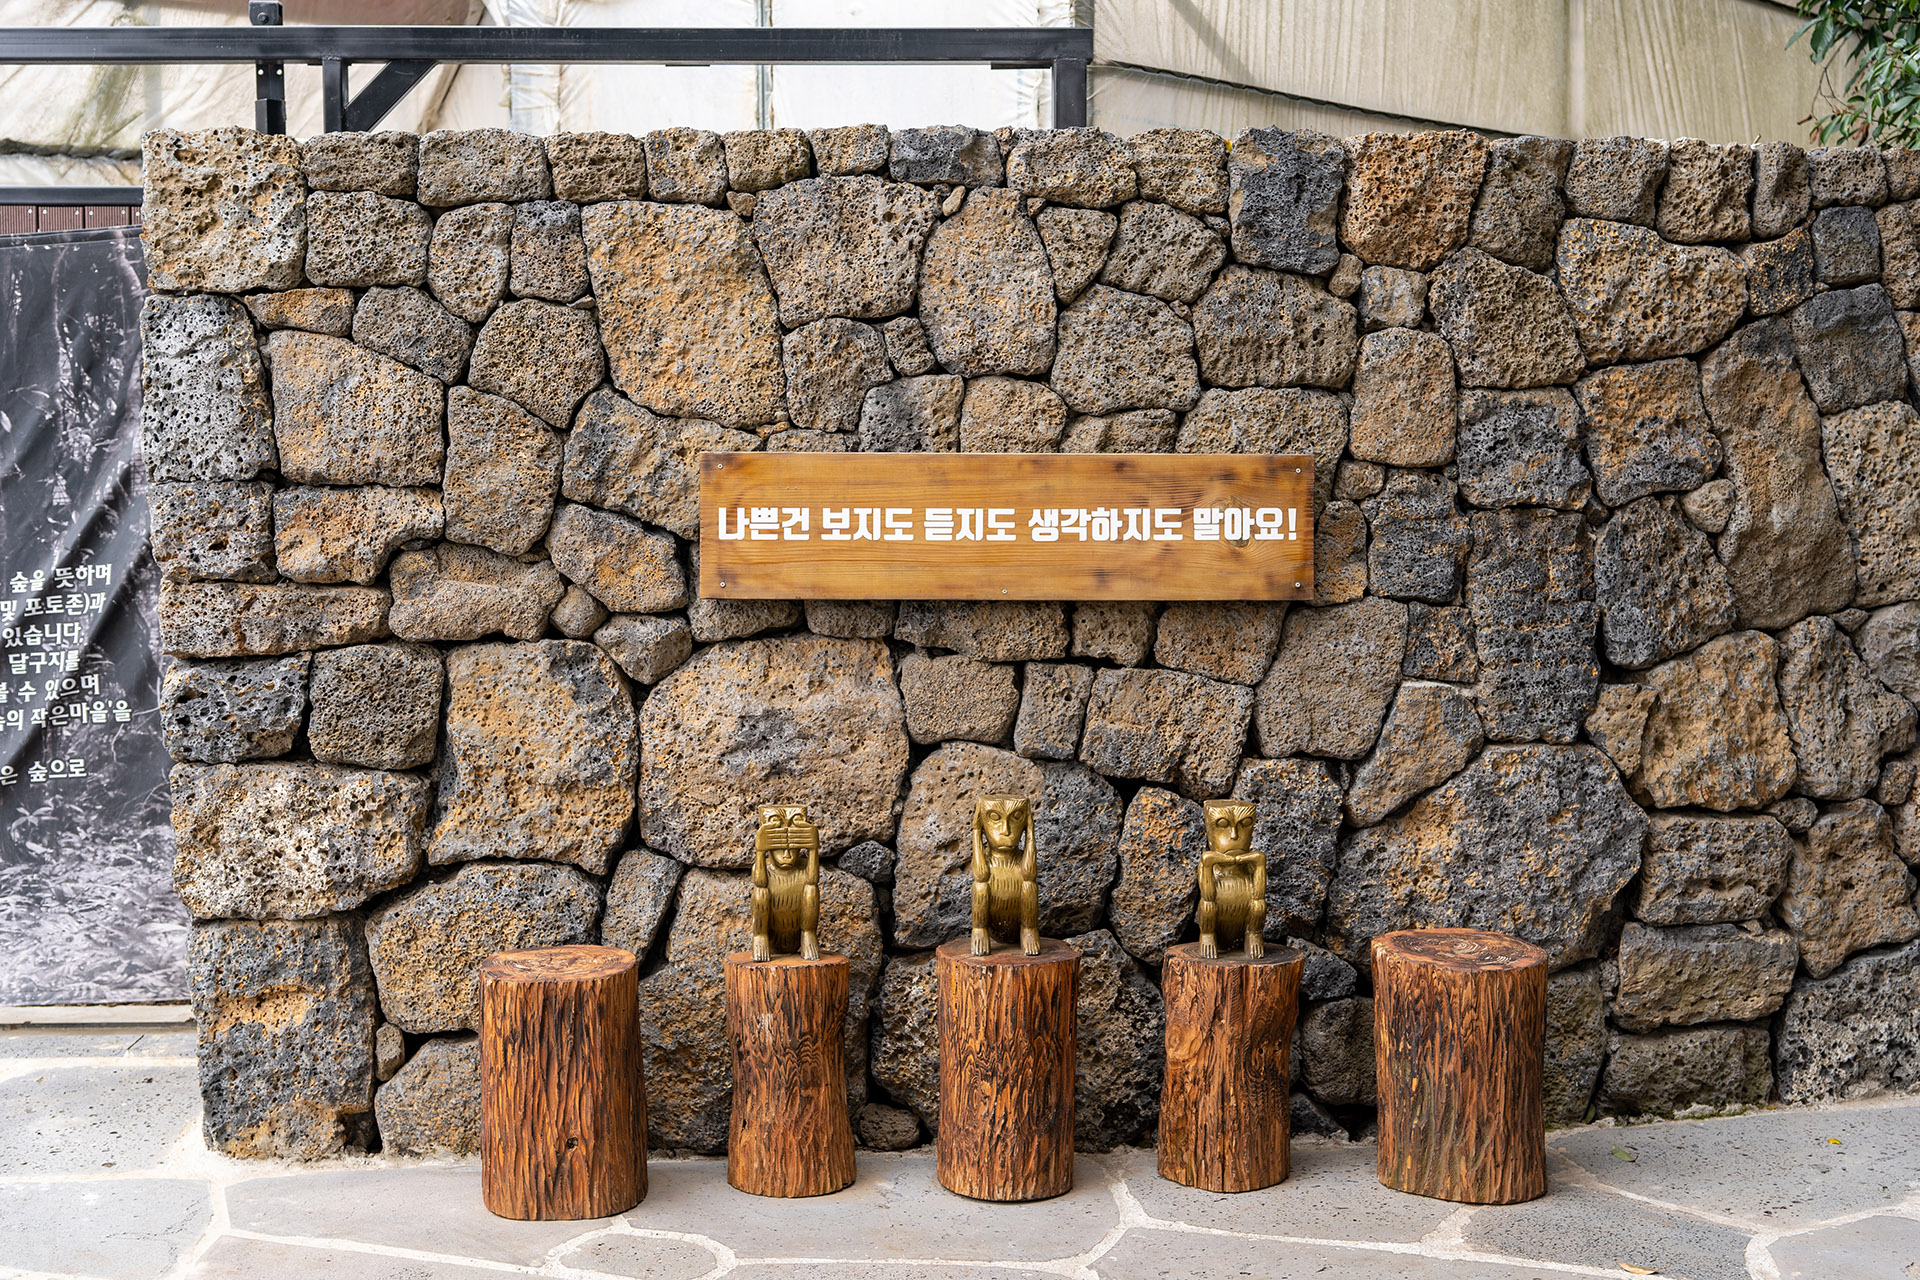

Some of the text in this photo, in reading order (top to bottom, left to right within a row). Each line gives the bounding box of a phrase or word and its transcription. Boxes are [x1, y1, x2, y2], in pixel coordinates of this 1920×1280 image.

[718, 506, 1297, 542] 나쁜건 보지도 듣지도 생각하지도 말아요!
[10, 563, 113, 593] 숲을 뜻하며
[0, 591, 107, 623] 및 포토존)과
[8, 649, 81, 675] 달구지를
[18, 680, 37, 703] 수
[45, 673, 101, 701] 있으며
[30, 699, 133, 729] 작은마을'을
[27, 758, 88, 783] 숲으로
